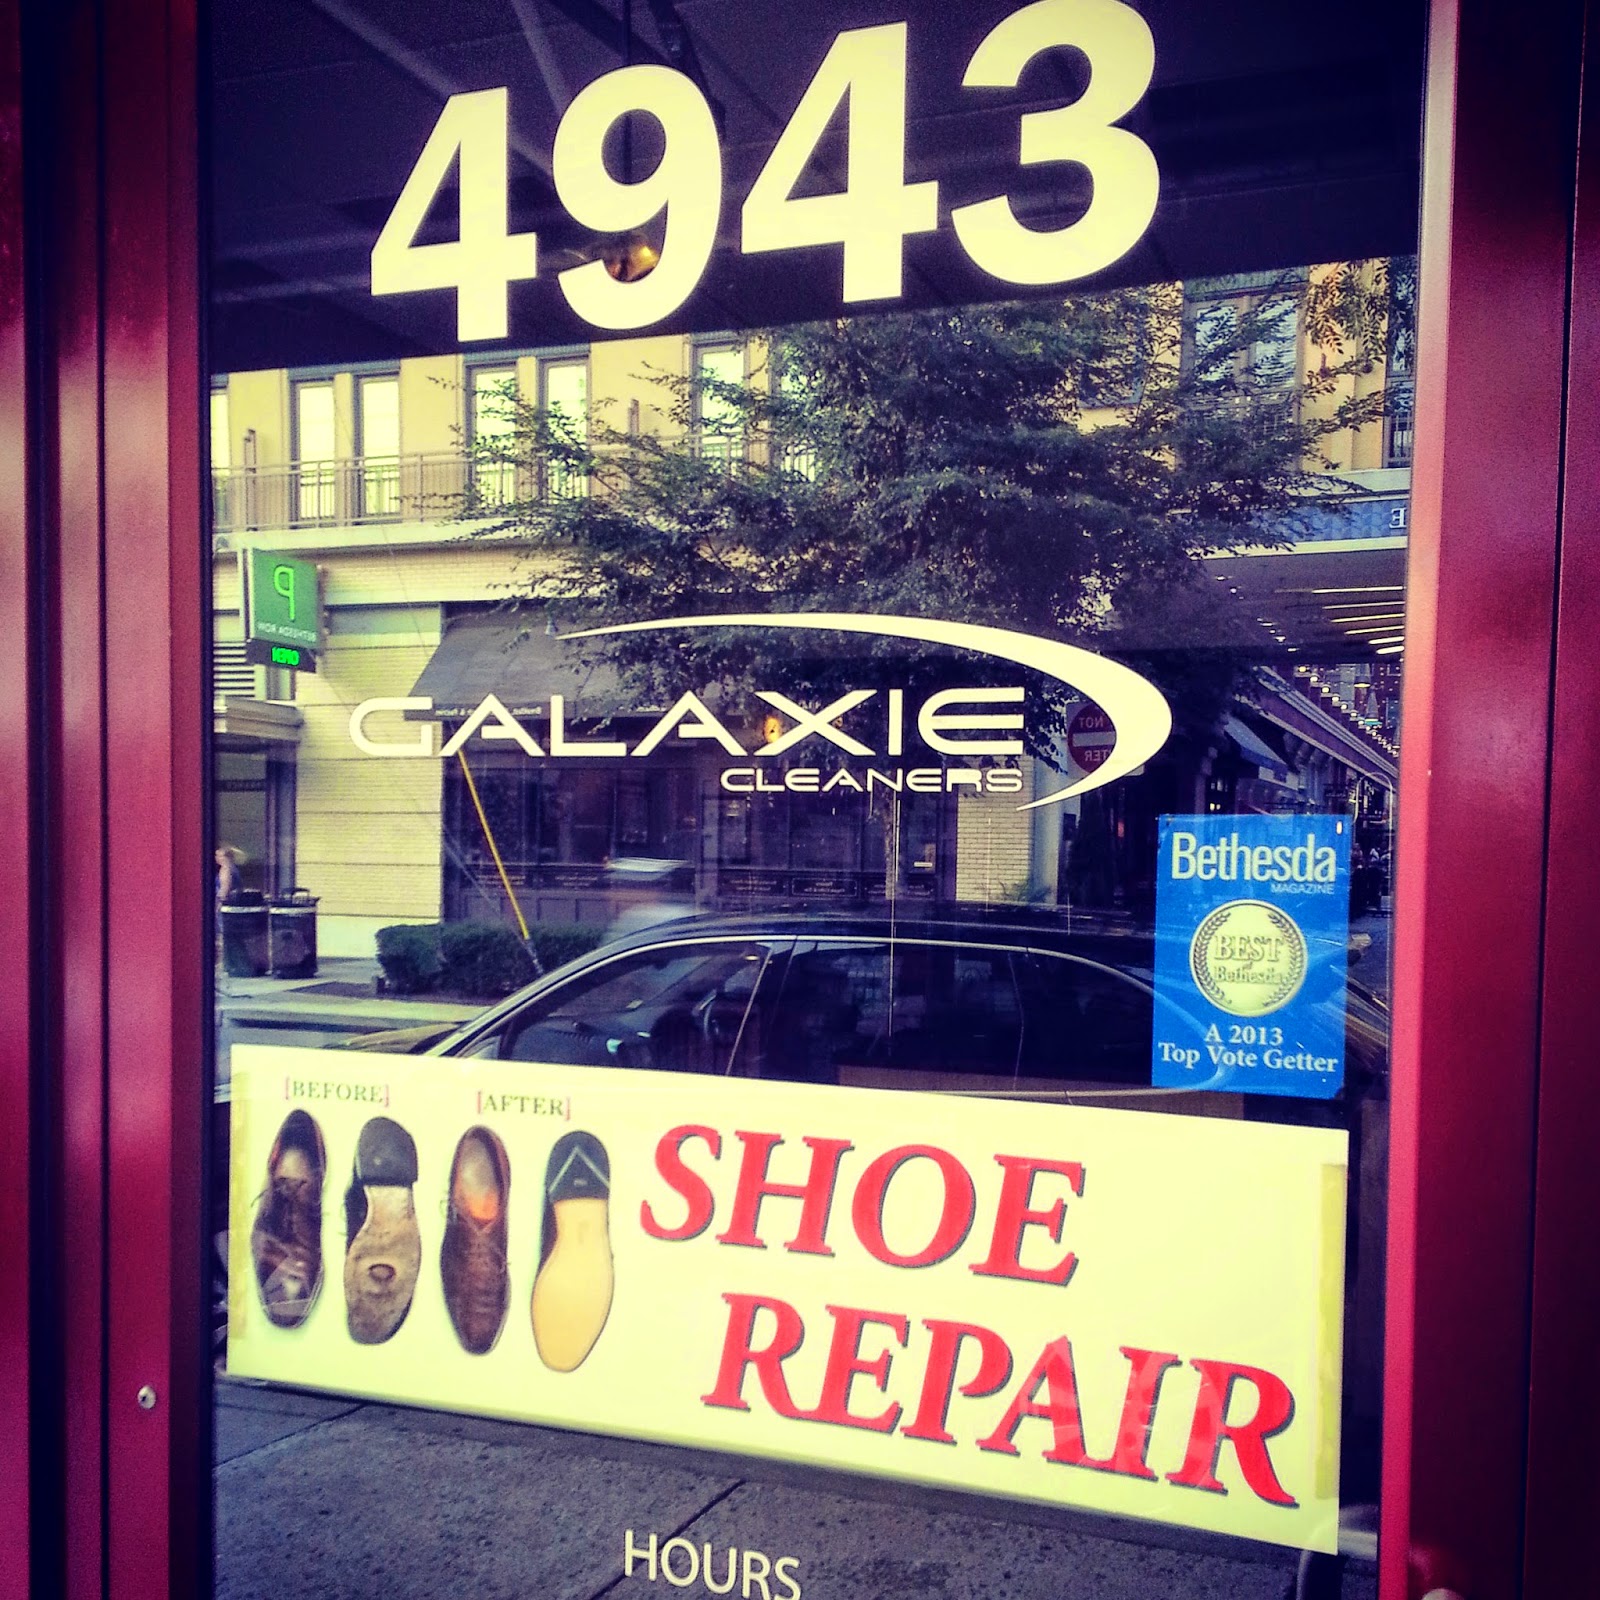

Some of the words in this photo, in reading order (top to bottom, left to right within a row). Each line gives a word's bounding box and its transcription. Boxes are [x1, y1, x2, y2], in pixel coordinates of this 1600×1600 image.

[370, 0, 1161, 342] 4943
[349, 686, 1026, 758] GALAXIE
[719, 767, 1024, 793] CLEANERS
[1171, 831, 1337, 883] Bethesda
[1270, 882, 1336, 895] MAGAZINE
[1214, 935, 1285, 962] BEST
[1157, 1042, 1200, 1069] Top
[1206, 1044, 1259, 1069] Vote
[1263, 1049, 1339, 1073] Getter
[1205, 1024, 1221, 1043] A
[1229, 1024, 1284, 1046] 2013
[640, 1123, 1086, 1288] SHOE
[700, 1292, 1300, 1508] REPAIR
[624, 1529, 801, 1600] HOURS
